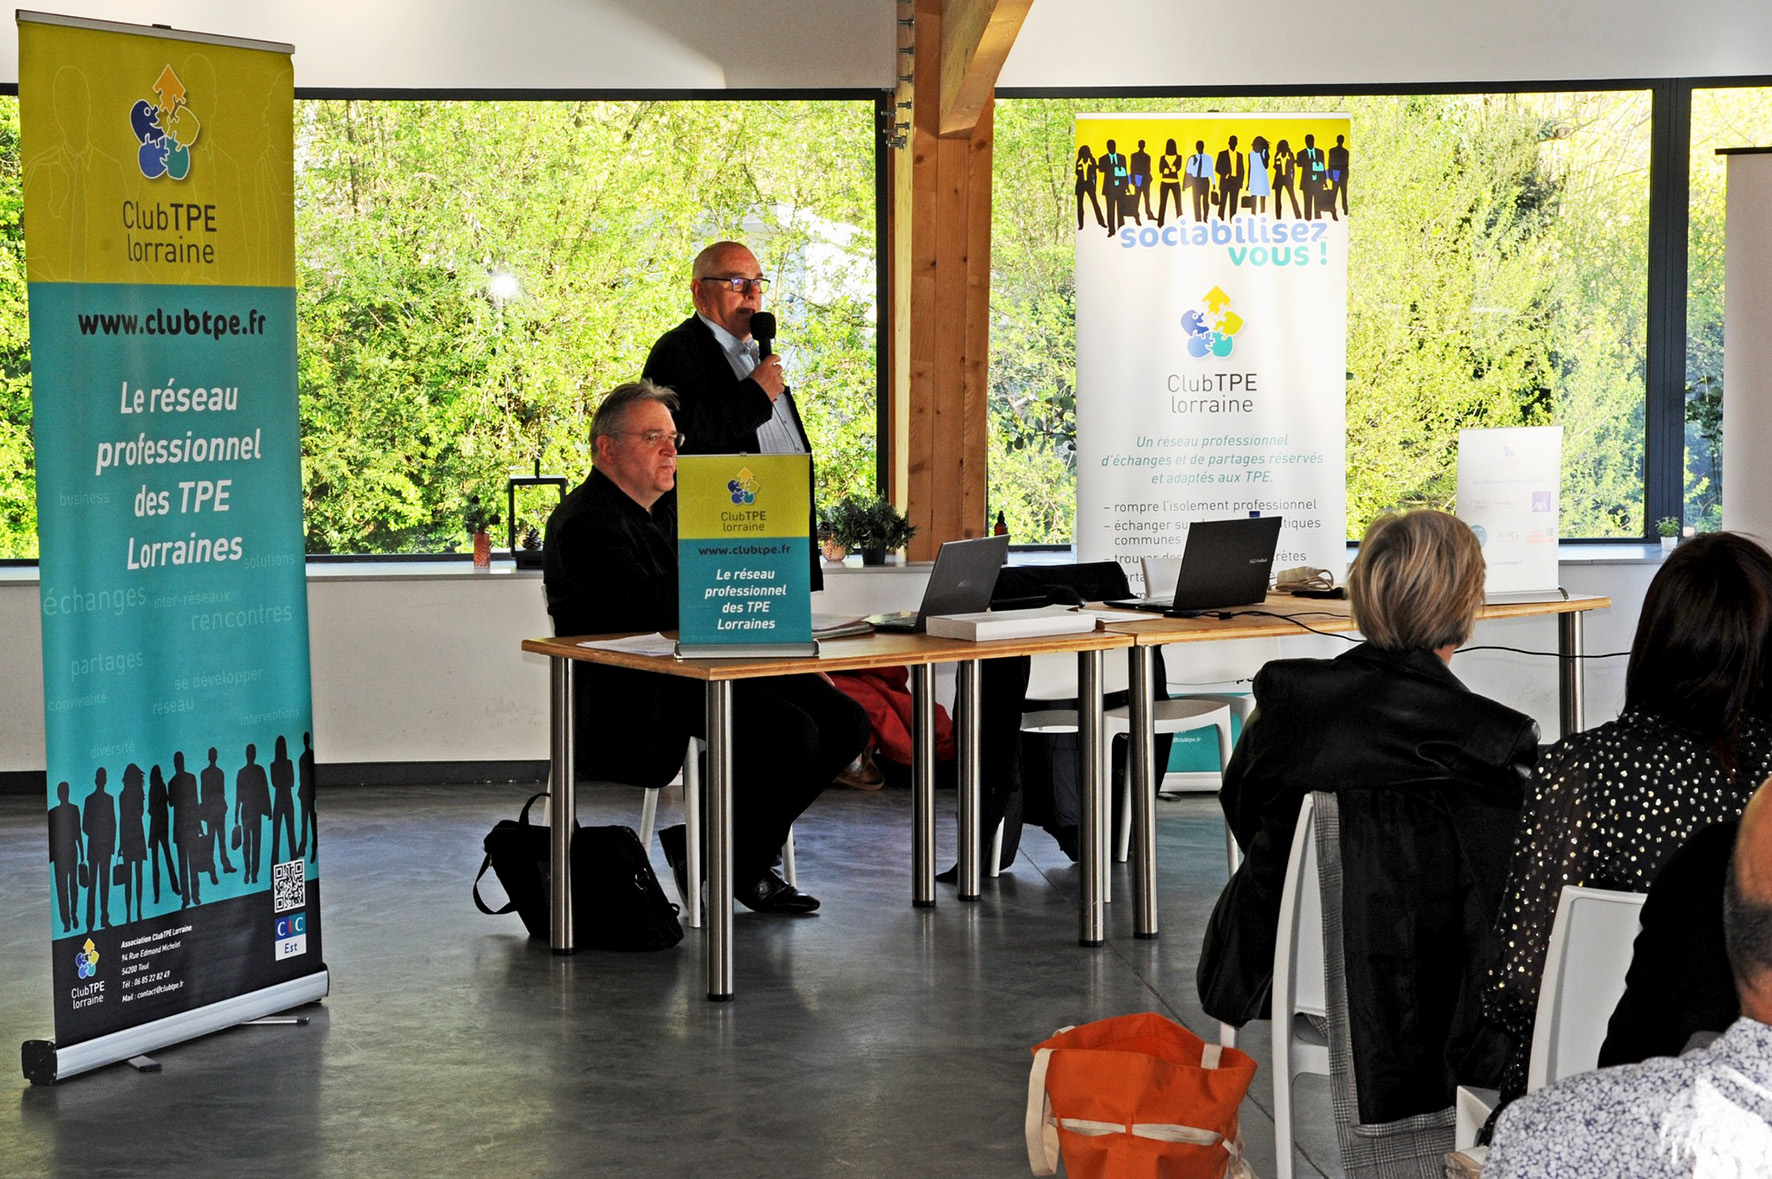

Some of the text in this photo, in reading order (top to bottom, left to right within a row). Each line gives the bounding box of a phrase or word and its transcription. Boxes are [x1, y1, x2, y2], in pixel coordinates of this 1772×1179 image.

[122, 200, 217, 232] ClubTPE
[1120, 216, 1328, 248] sociabilisez
[128, 234, 214, 264] lorraine
[1228, 245, 1310, 267] vous
[78, 308, 266, 340] www.clubtpe.fr
[1167, 373, 1258, 393] ClubTPE
[120, 378, 238, 414] Le réseau
[1171, 395, 1254, 414] lorraine
[1136, 434, 1288, 450] Un réseau professionnel
[96, 428, 262, 476] professionnel
[1101, 452, 1324, 470] d'échanges et de partages réservés
[1151, 471, 1273, 486] et adaptés aux TPE.
[134, 480, 232, 517] des TPE
[1114, 499, 1317, 515] rompre l'isolement professionnel
[720, 510, 766, 522] ClubTPE
[723, 522, 765, 532] lorraine
[1114, 520, 1172, 533] échanger
[1175, 521, 1188, 530] su
[698, 545, 791, 555] www.clubtpe.fr
[1114, 536, 1181, 545] communes
[127, 532, 243, 570] Lorraines
[244, 552, 296, 570] solutions
[716, 568, 775, 580] Le réseau
[43, 586, 146, 616] échanges
[704, 584, 787, 600] professionnel
[722, 602, 744, 613] des
[747, 601, 770, 612] TPE
[192, 604, 292, 632] rencontres
[717, 618, 776, 630] Lorraines
[71, 651, 144, 682] partages
[174, 667, 263, 690] se développer
[121, 925, 192, 948] Association ClubTPE Lorraine
[129, 952, 139, 960] Rue
[140, 946, 161, 958] Edmond
[162, 940, 181, 953] Michelet
[284, 942, 298, 954] Est
[122, 962, 150, 976] 54200 Toul
[148, 974, 156, 982] 22
[71, 980, 106, 999] ClubTPE
[137, 980, 184, 999] contact@clubtpe.fr
[73, 994, 104, 1010] lorraine
